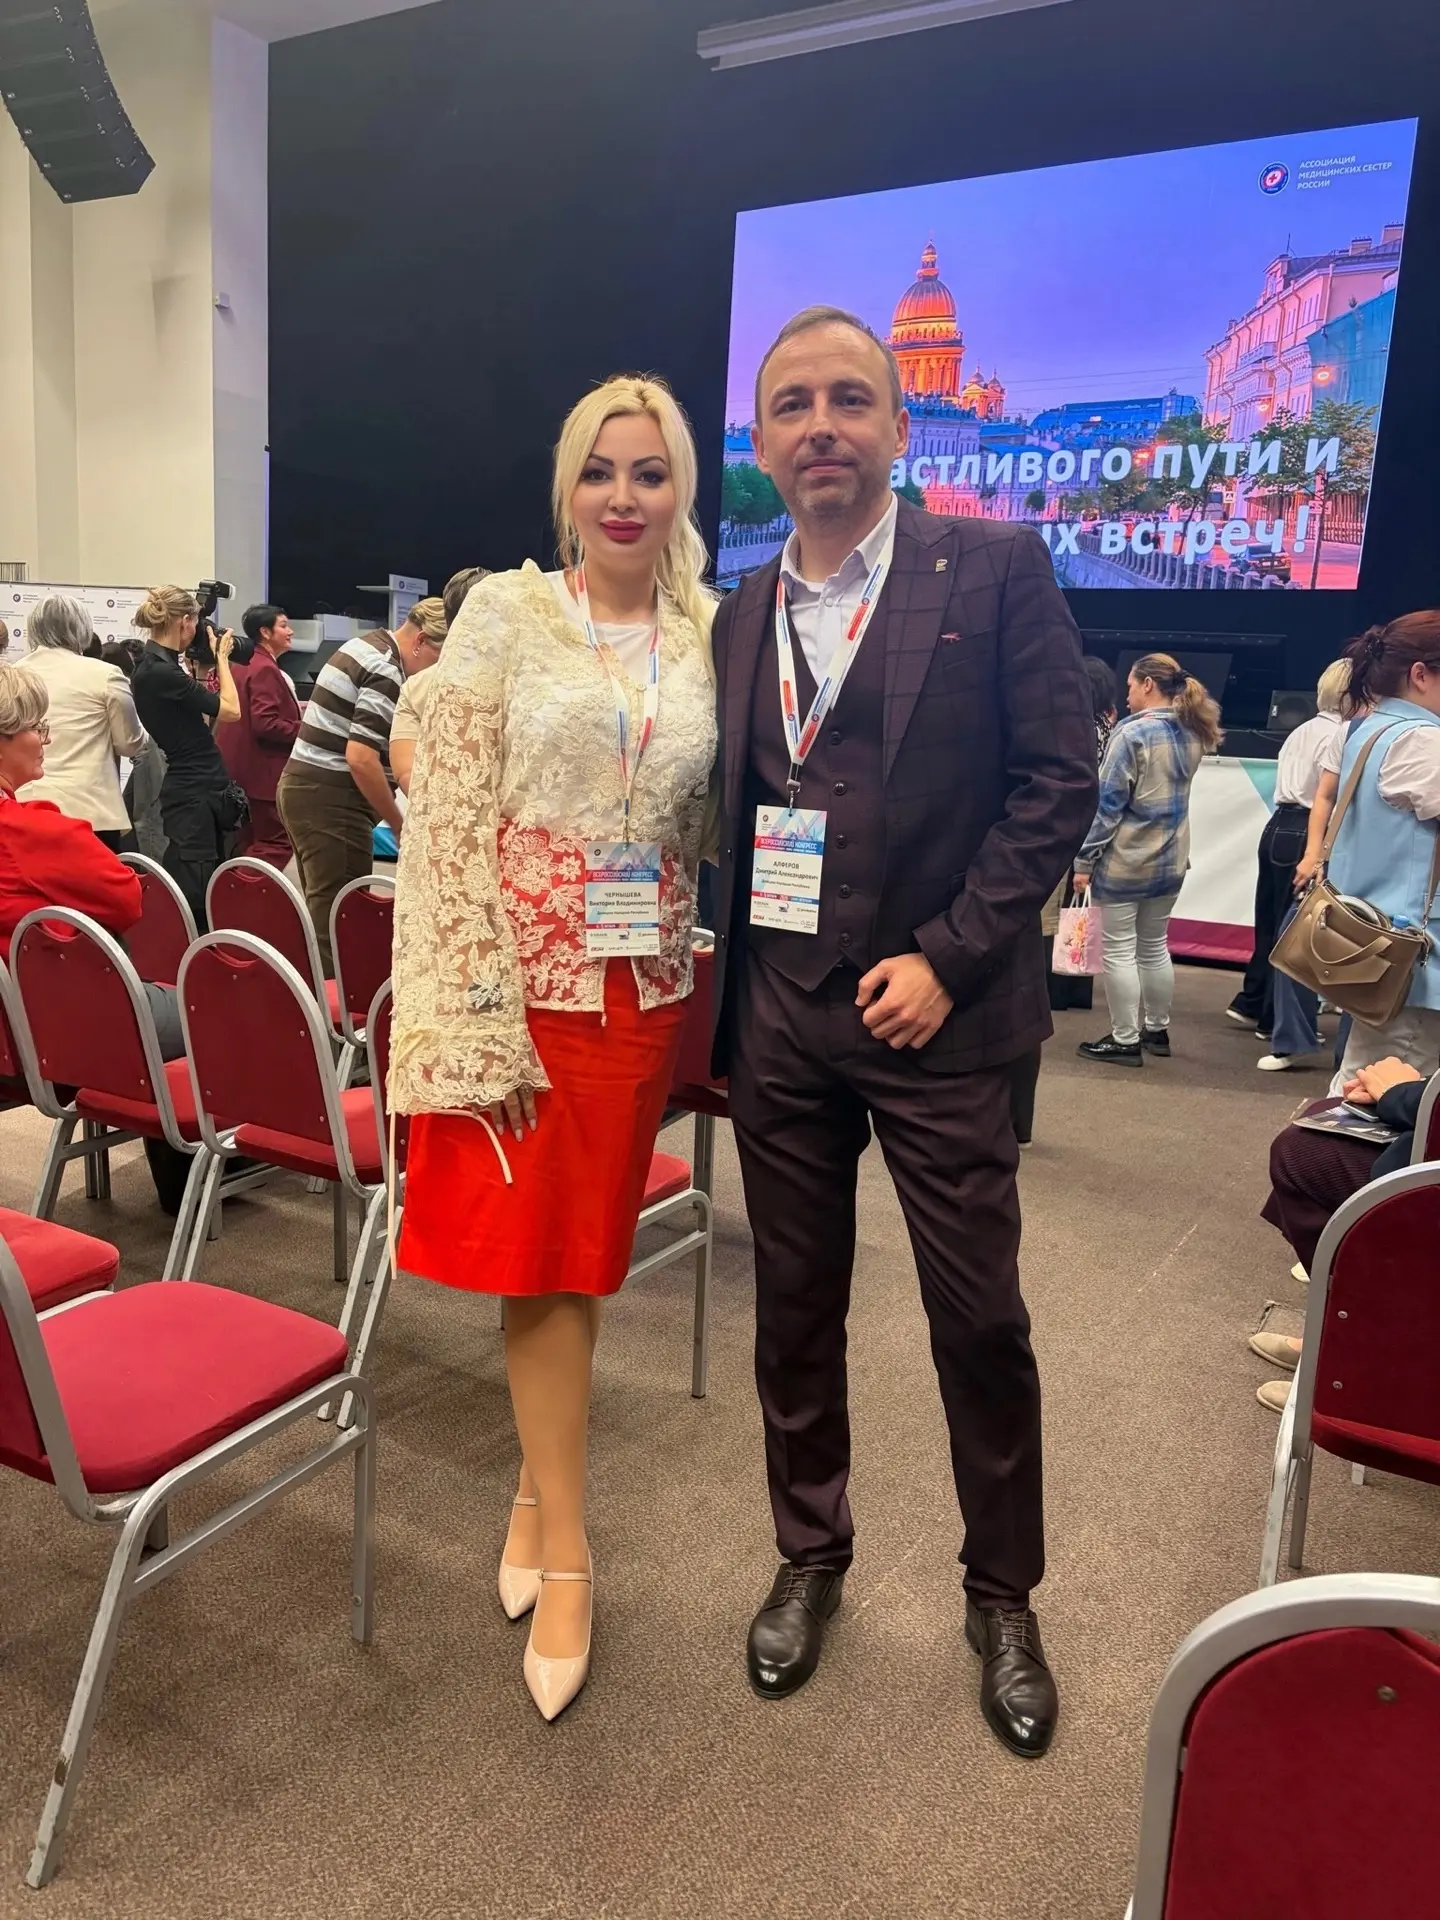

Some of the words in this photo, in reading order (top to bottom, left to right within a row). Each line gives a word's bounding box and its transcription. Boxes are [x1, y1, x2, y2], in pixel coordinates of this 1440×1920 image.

[1298, 166, 1361, 179] МЕДИЦИНСКИХ
[1362, 162, 1392, 172] СЕСТЕР
[1299, 156, 1356, 168] АССОЦИАЦИЯ
[1297, 180, 1330, 190] РОССИИ
[890, 446, 1133, 488] астливого
[1152, 439, 1282, 490] пути
[1305, 436, 1340, 474] и
[1100, 505, 1310, 565] встреч!
